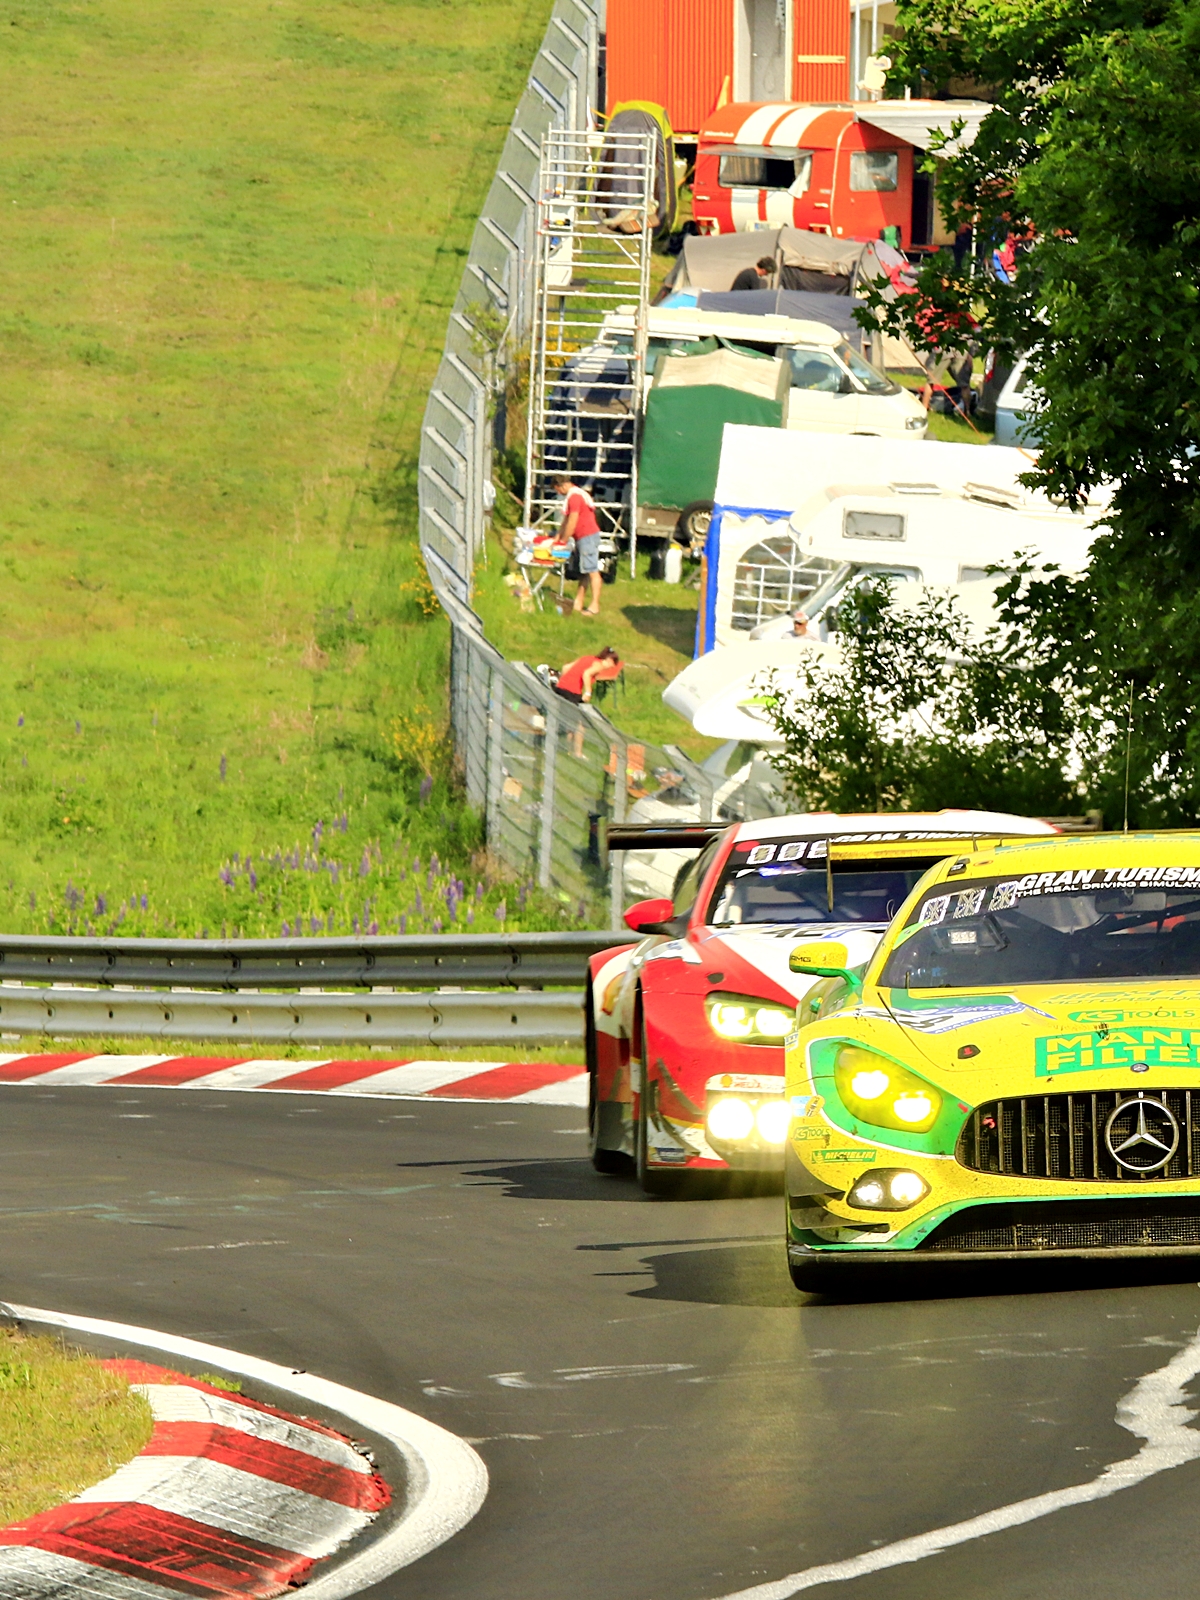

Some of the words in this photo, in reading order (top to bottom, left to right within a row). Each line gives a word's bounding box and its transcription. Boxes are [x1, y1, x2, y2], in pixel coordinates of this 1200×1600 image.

[1016, 868, 1097, 891] GRAN
[1016, 889, 1041, 898] THE
[1043, 885, 1080, 895] REAL
[1081, 881, 1137, 891] DRIVING
[1123, 1008, 1197, 1019] TOOLS
